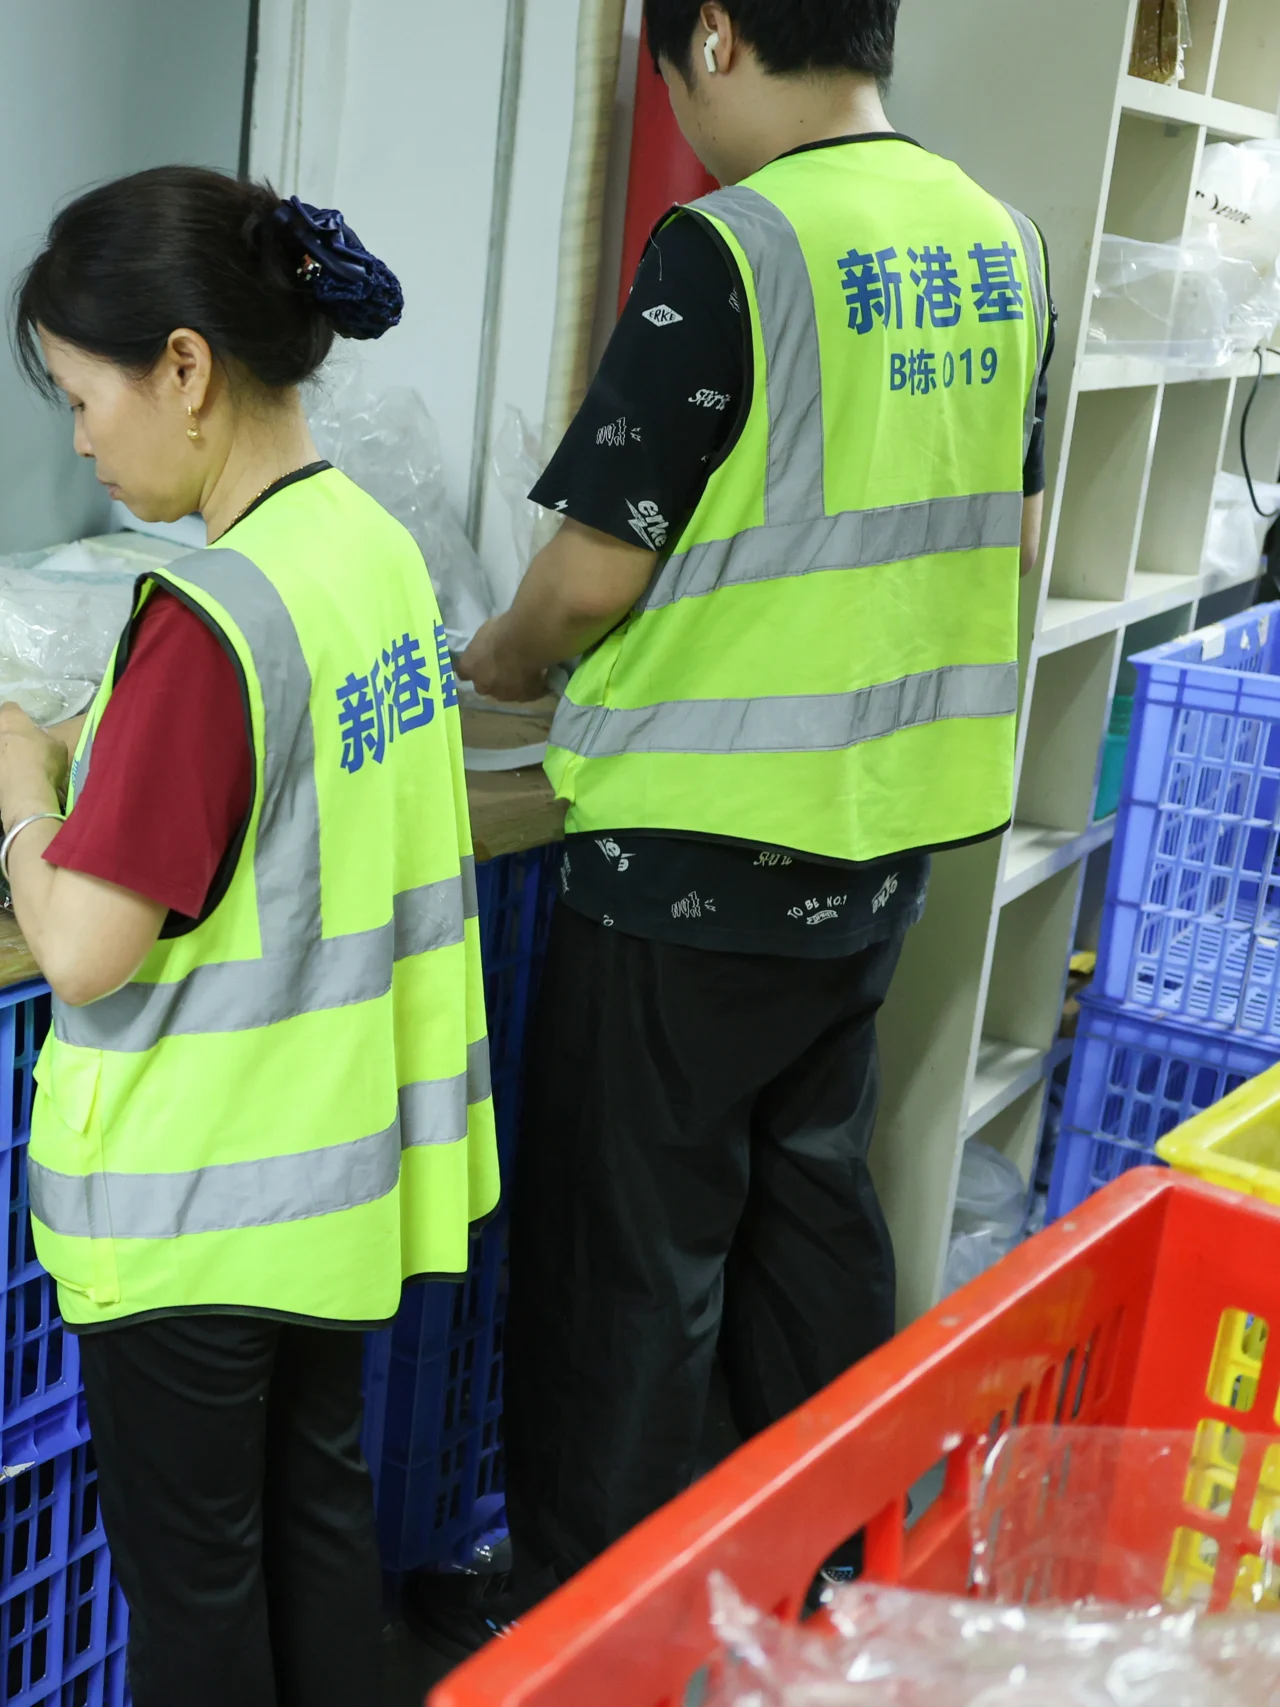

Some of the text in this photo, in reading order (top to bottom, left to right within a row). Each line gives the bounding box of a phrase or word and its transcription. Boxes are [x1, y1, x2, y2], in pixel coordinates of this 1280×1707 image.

[836, 240, 1024, 335] 新港基
[648, 309, 676, 323] ERKE
[890, 346, 998, 396] B栋019
[787, 906, 804, 919] TO
[805, 897, 820, 911] BE
[826, 894, 847, 908] NO.1
